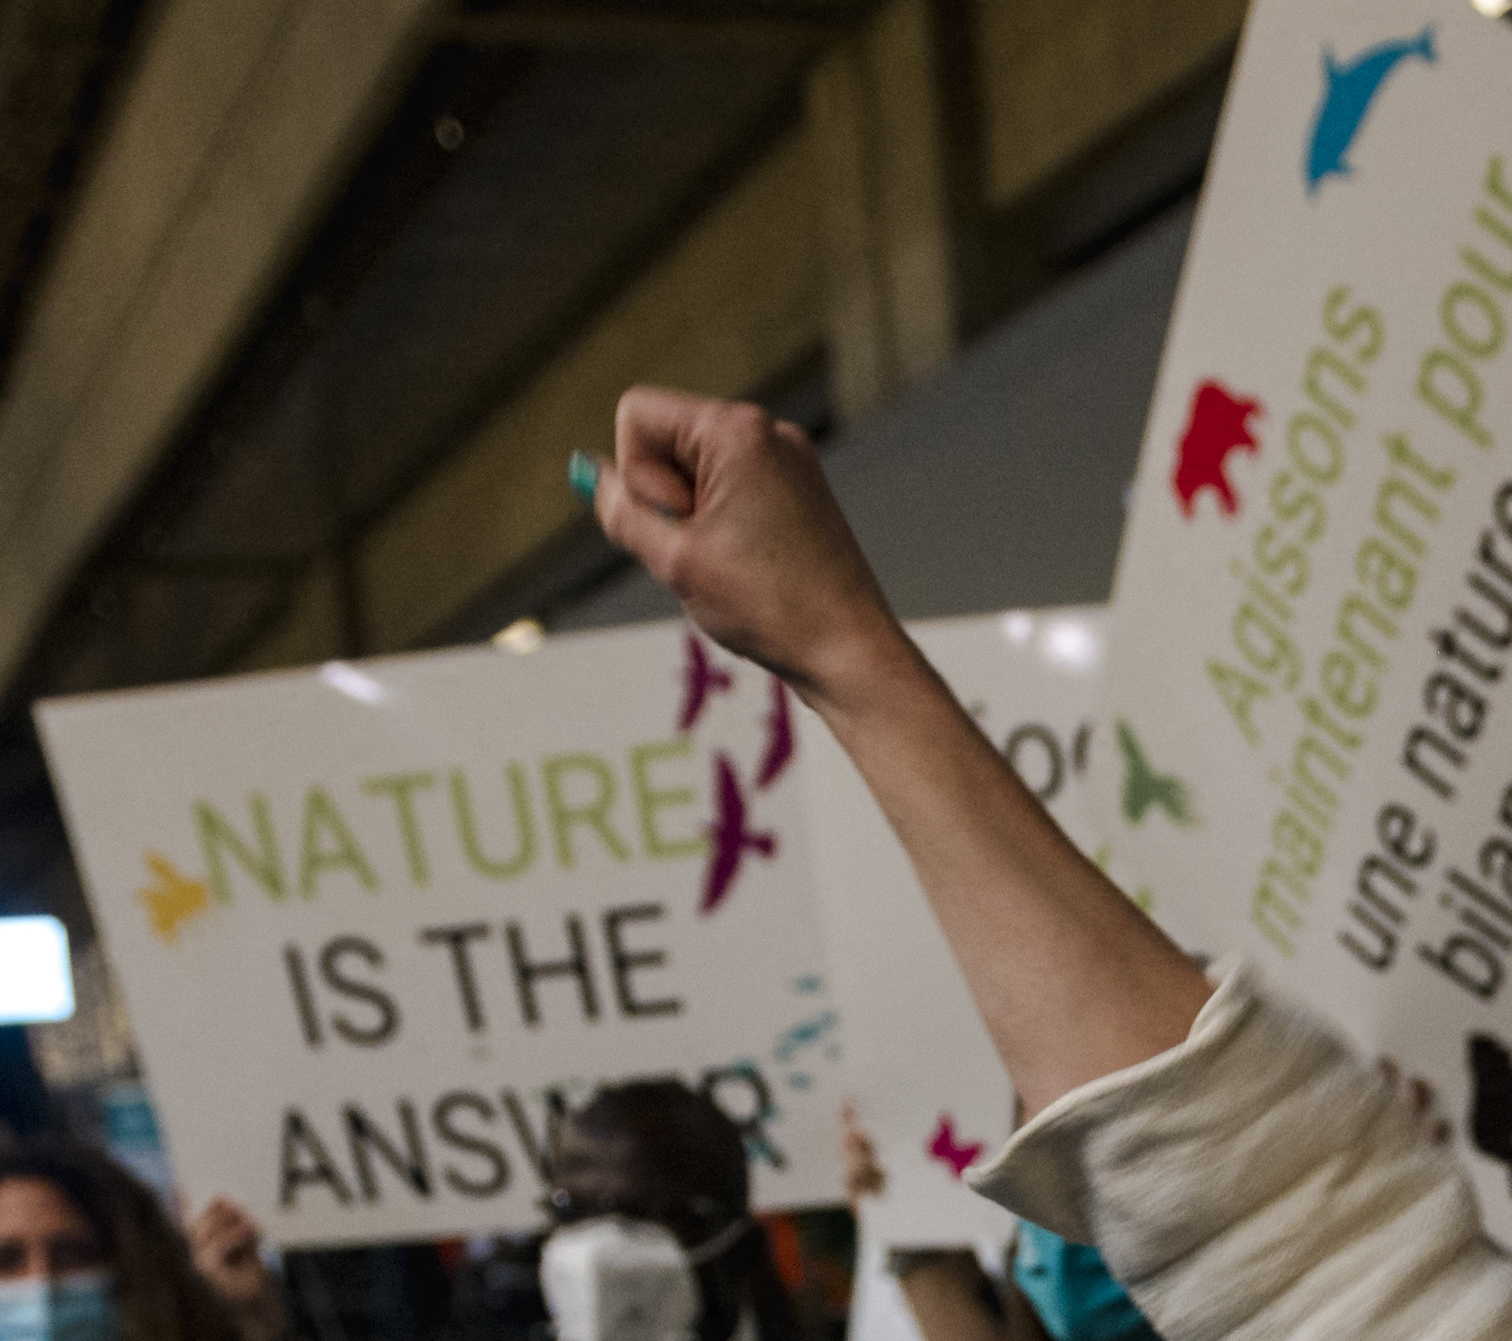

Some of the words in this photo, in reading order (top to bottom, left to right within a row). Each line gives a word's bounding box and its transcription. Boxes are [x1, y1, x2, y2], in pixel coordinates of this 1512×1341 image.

[1204, 283, 1389, 741] Agissons
[1251, 430, 1459, 954] maintenant
[192, 740, 709, 905] NATURE
[1339, 799, 1439, 975] une
[283, 932, 399, 1048] IS
[418, 903, 684, 1036] THE
